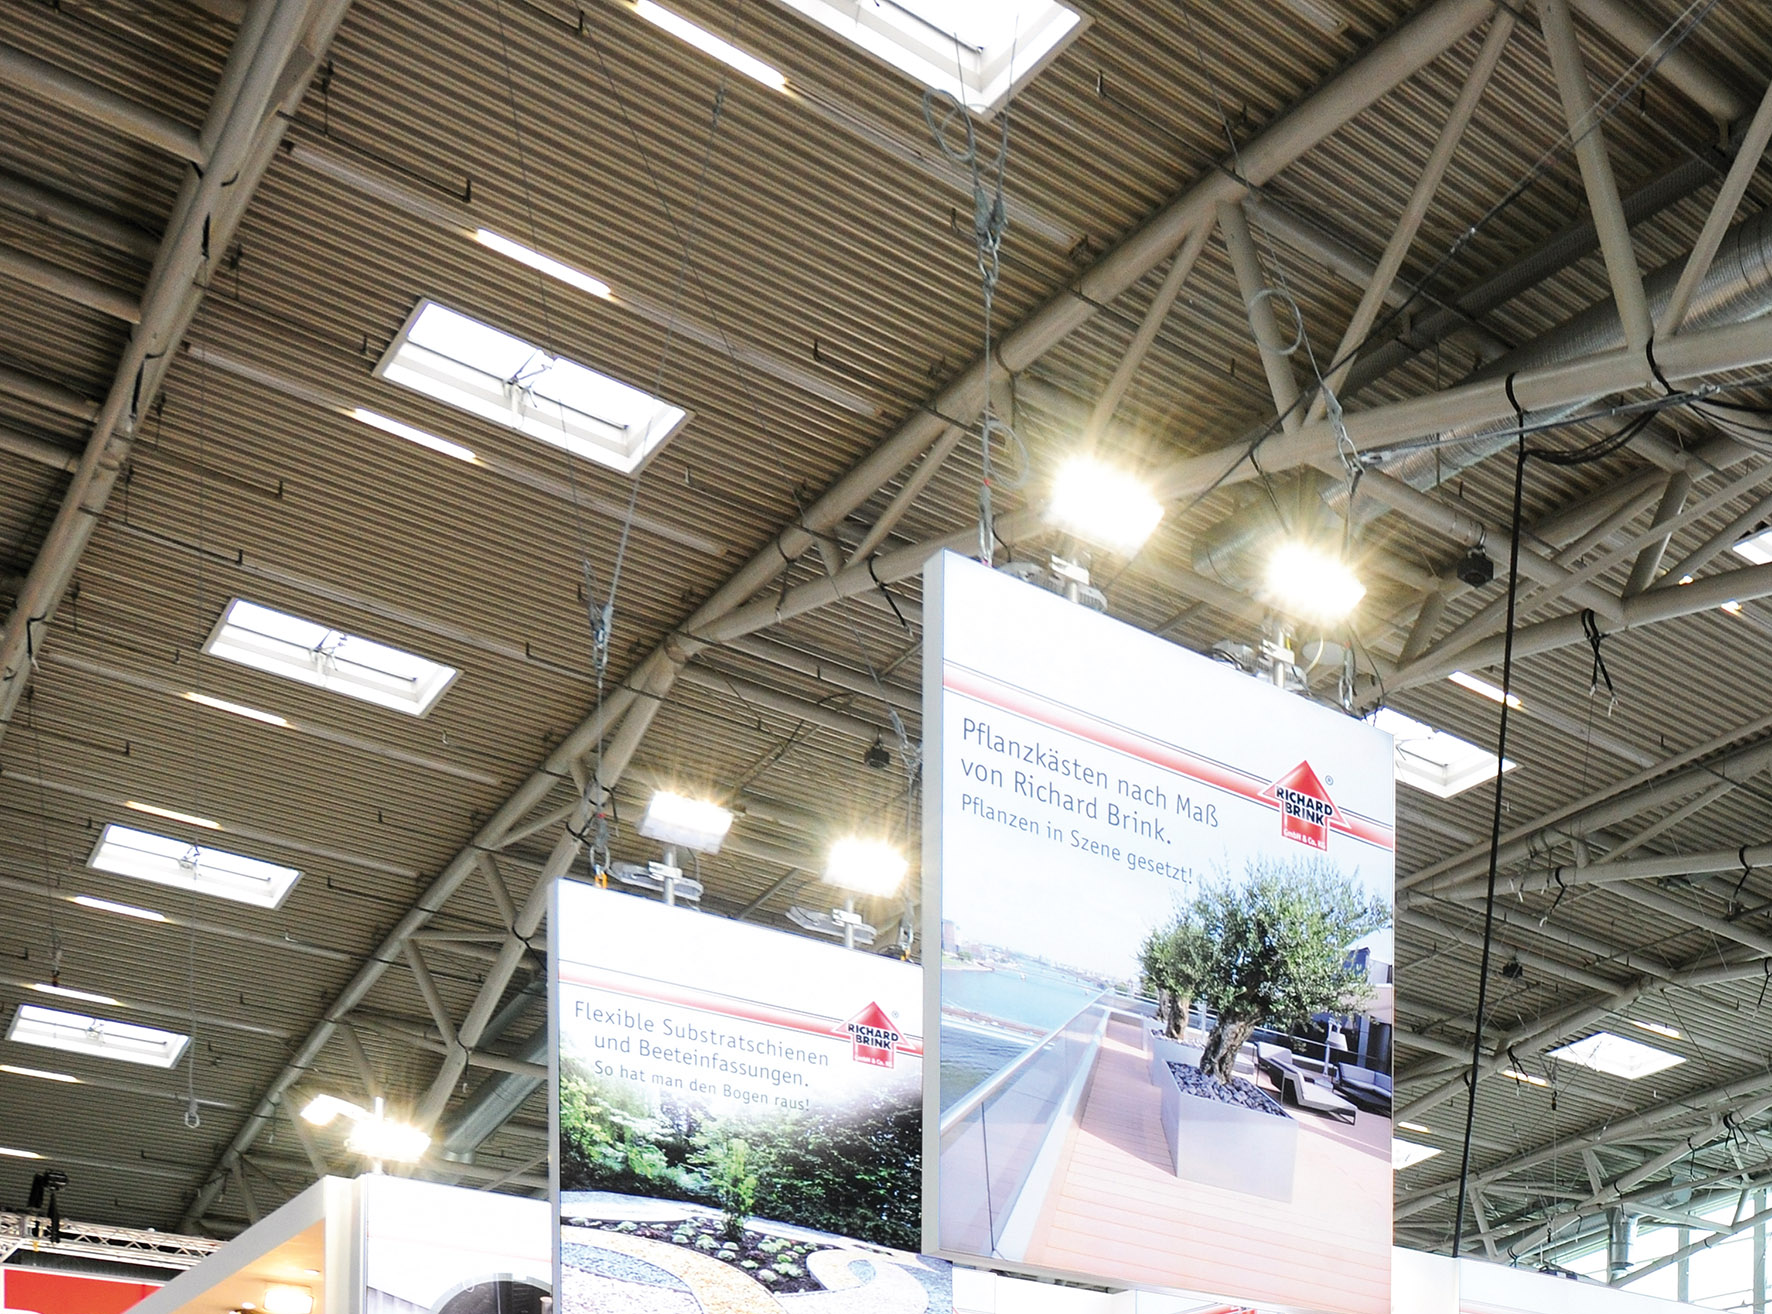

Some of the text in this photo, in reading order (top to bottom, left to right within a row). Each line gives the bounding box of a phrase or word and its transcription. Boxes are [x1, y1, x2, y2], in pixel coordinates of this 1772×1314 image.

[962, 717, 1220, 828] Pflanzkästen nach Maß
[960, 757, 1172, 845] von Richard Brink.
[1276, 785, 1333, 816] RICHARD
[1285, 802, 1325, 826] BRINK
[961, 793, 1193, 885] Pflanzen in Szene gesetzt!
[574, 1000, 830, 1067] Flexible Substratschienen
[848, 1023, 899, 1042] RICHARD
[856, 1034, 891, 1050] BRINK
[594, 1033, 810, 1089] und Beeteinfassungen.
[594, 1059, 810, 1112] So hat man den Bogen raus!
